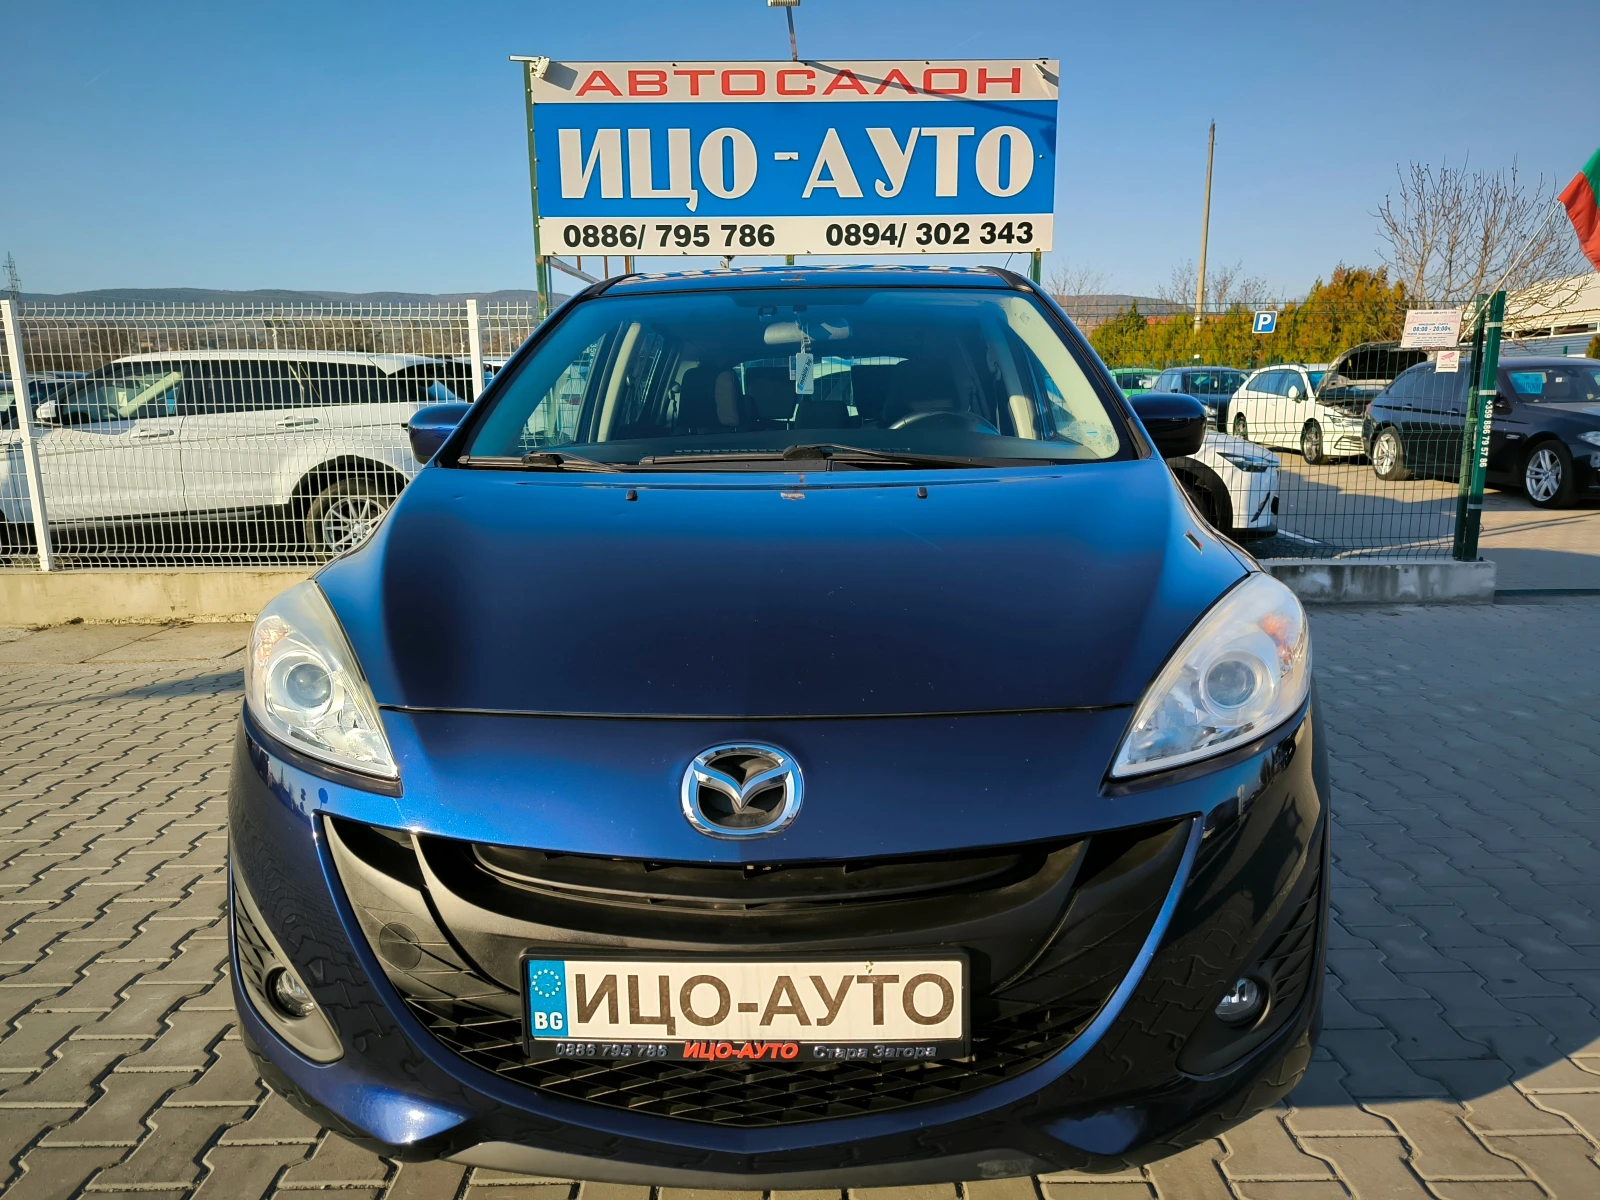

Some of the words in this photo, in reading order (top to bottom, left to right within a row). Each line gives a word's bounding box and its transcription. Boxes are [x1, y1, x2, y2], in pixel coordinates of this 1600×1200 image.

[576, 68, 1022, 97] АВТОСАЛОН
[563, 225, 646, 250] 0886/
[655, 225, 710, 248] 795
[720, 224, 775, 247] 786
[825, 223, 906, 248] 0894/
[915, 223, 970, 246] 302
[979, 222, 1033, 245] 343
[1257, 314, 1272, 331] P
[574, 973, 956, 1035] ИЦО-АУТО
[534, 1011, 563, 1030] BG
[555, 1042, 597, 1057] 0886
[601, 1043, 632, 1057] 795
[636, 1043, 669, 1058] 786
[682, 1040, 799, 1061] ИЦО-АУТО
[813, 1045, 869, 1060] Стара
[872, 1044, 937, 1060] Загора
